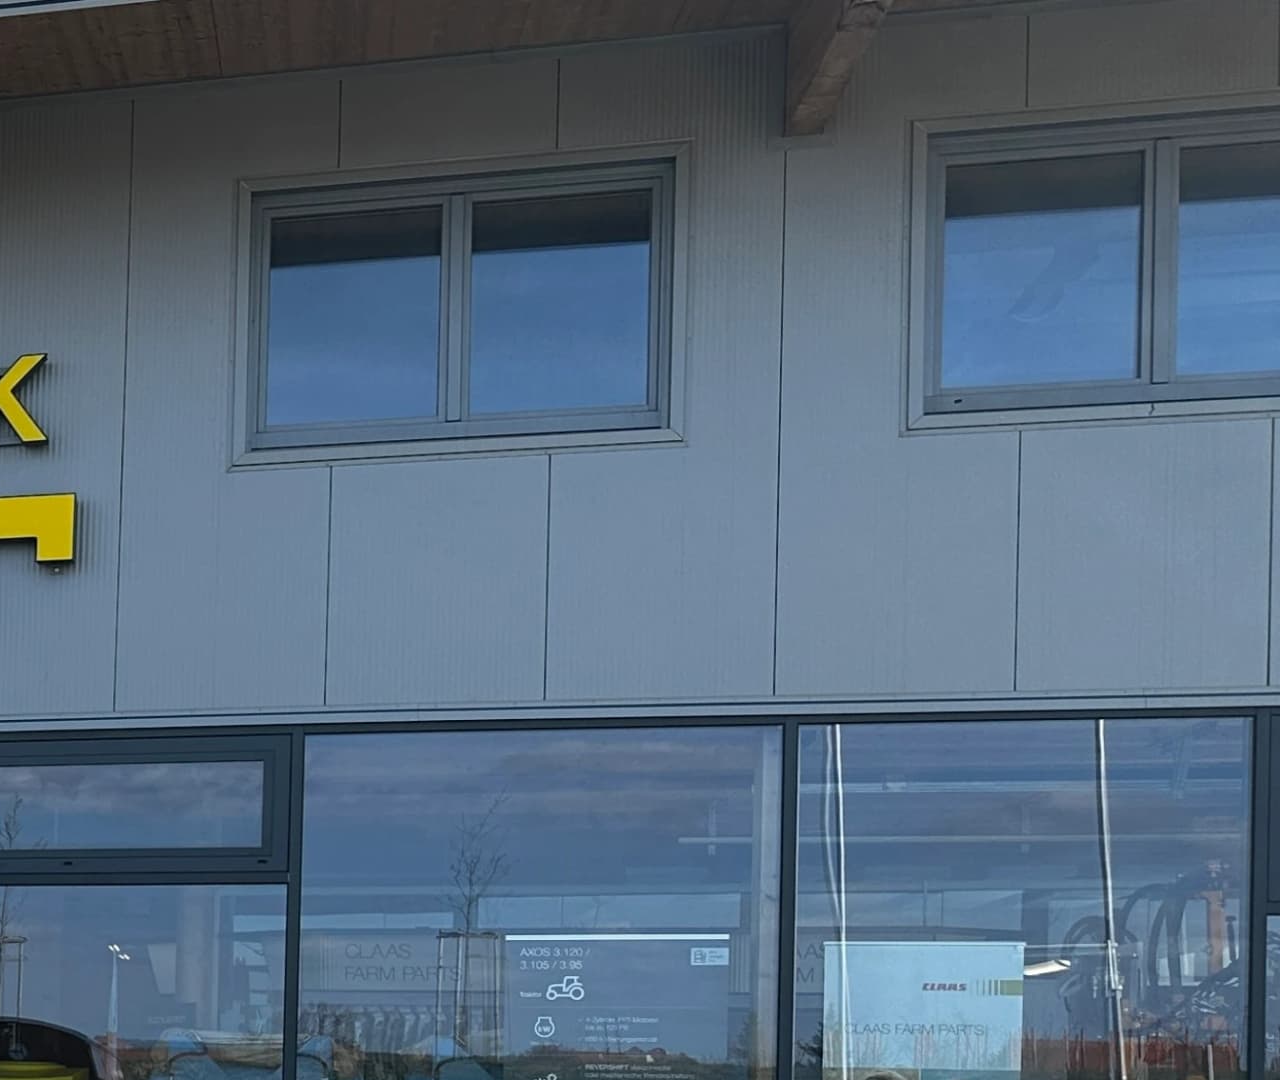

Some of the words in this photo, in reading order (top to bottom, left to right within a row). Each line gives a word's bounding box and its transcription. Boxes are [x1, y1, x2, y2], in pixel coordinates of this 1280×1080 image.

[344, 943, 413, 960] CLAAS
[520, 948, 551, 957] AXOS
[344, 966, 396, 981] FARM
[922, 983, 967, 992] CLAAS
[895, 1022, 934, 1035] FARM
[939, 1023, 985, 1036] PARTS
